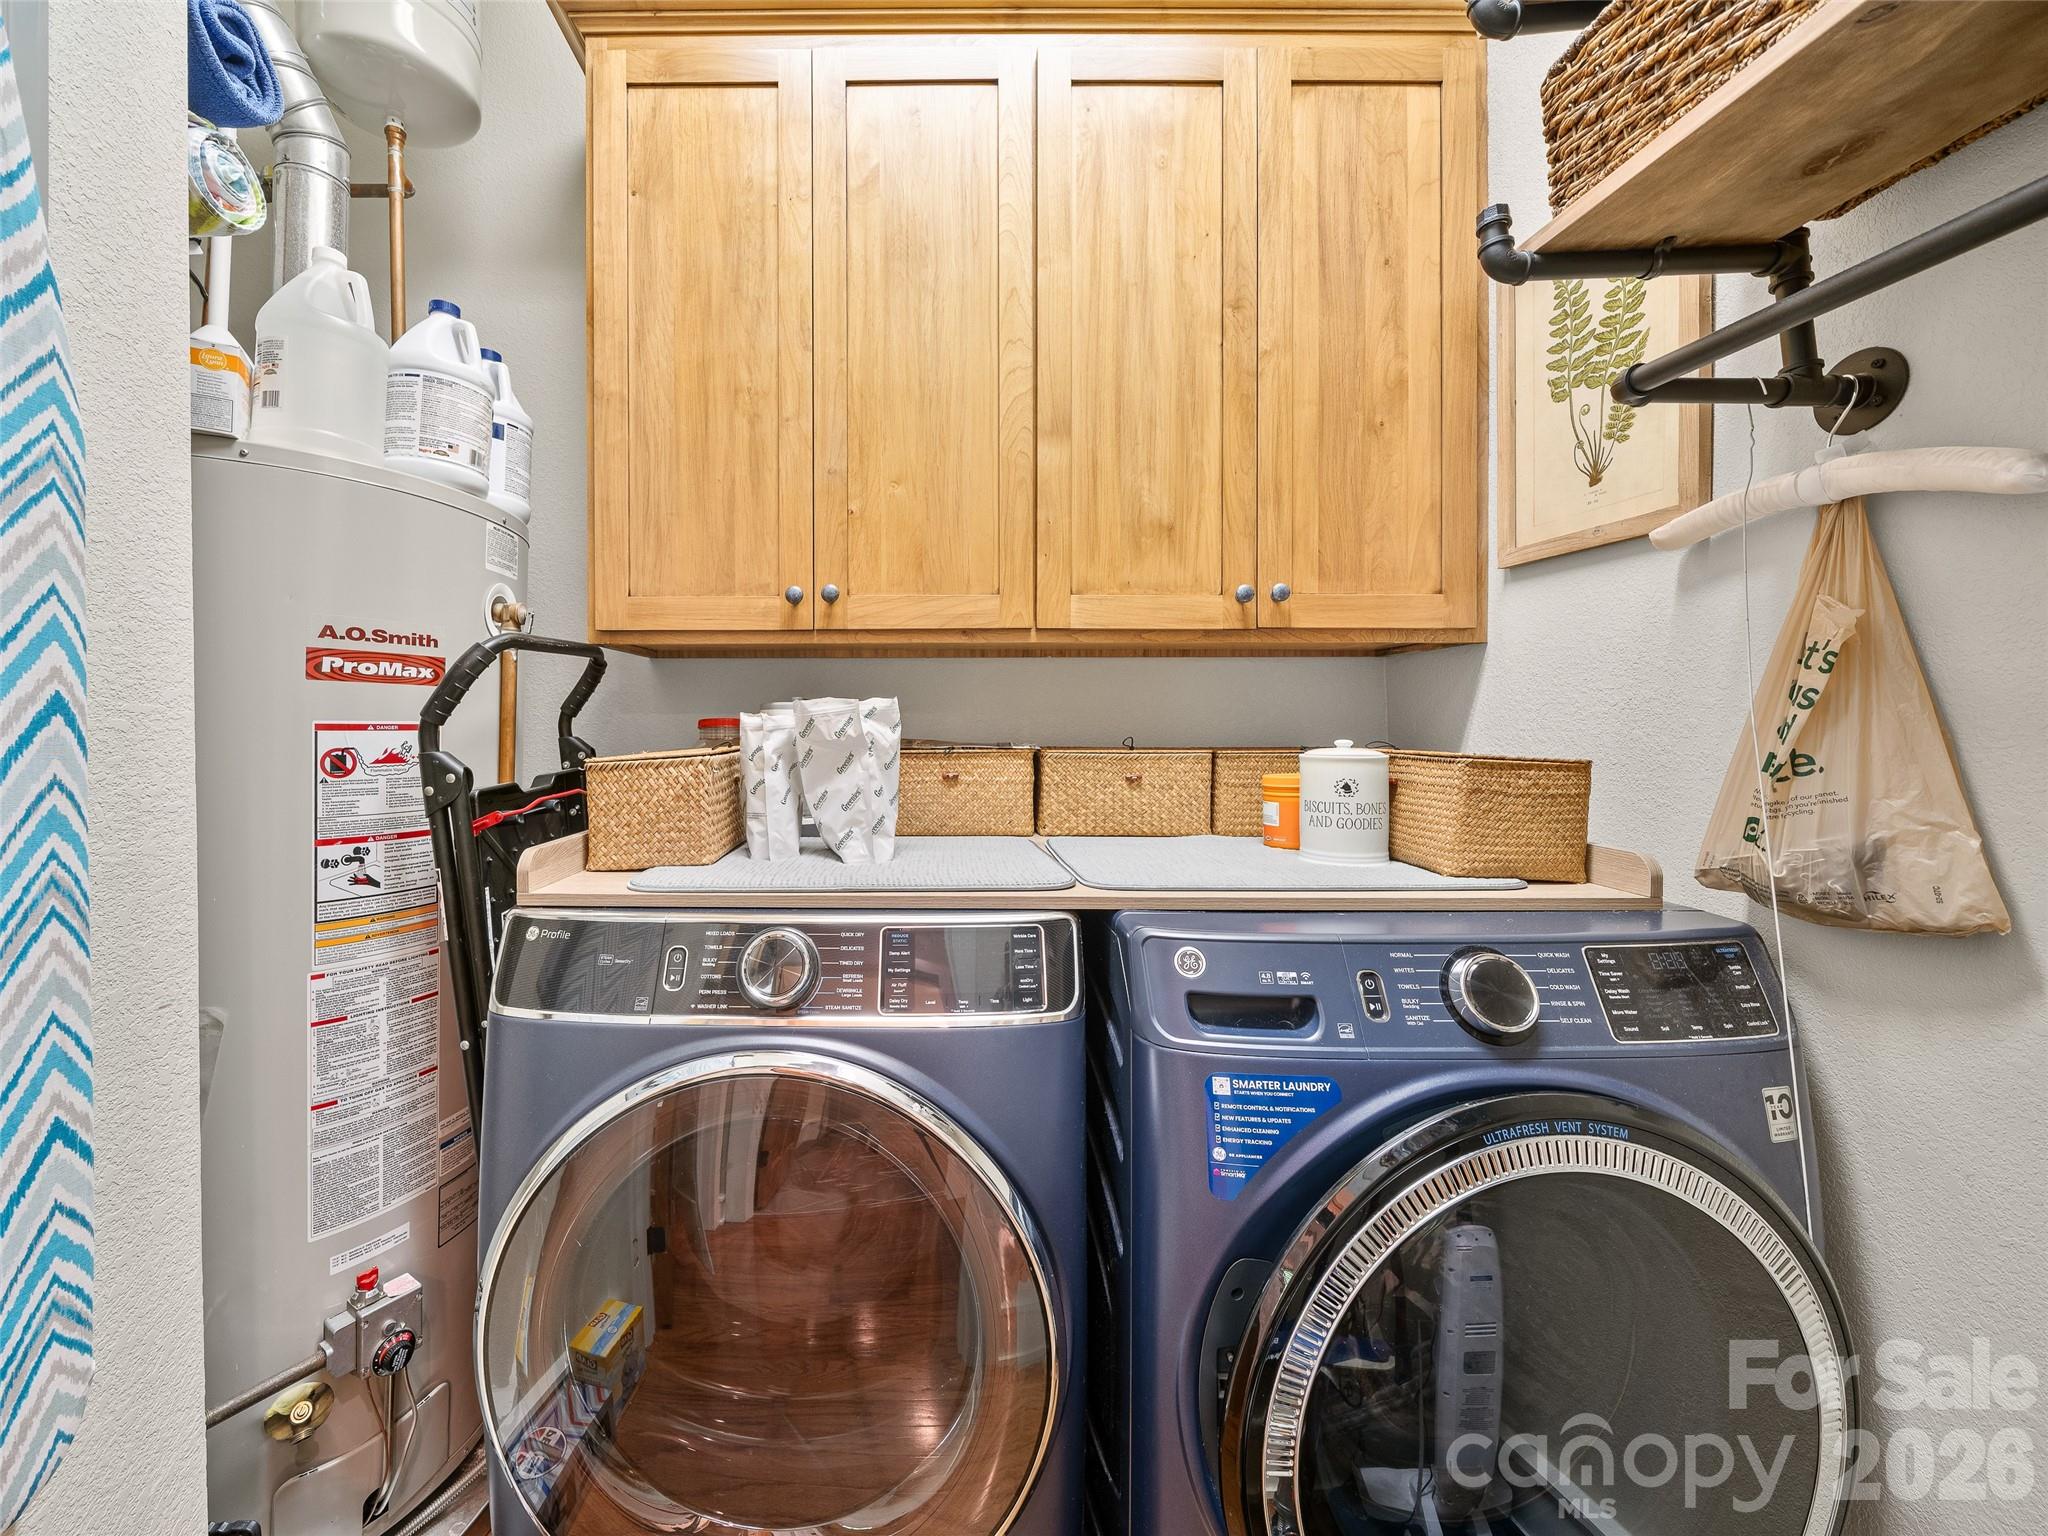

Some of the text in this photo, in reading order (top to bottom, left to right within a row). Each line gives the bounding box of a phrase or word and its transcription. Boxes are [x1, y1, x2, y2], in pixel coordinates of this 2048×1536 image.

[317, 624, 439, 648] A.O.Smith
[320, 656, 434, 679] ProMax
[799, 714, 816, 740] Greenies
[834, 714, 854, 740] Greenies
[836, 751, 855, 775] Greenies
[812, 787, 829, 811] Greenies
[841, 786, 863, 812] Greenies
[1303, 799, 1387, 816] BISCUITS, BONES
[1308, 815, 1383, 830] AND GOODIES
[834, 825, 854, 852] Greenies
[540, 928, 571, 940] Profile
[354, 964, 374, 972] SAFETY
[1232, 1079, 1331, 1092] SMARTER LAUNDRY
[1220, 1103, 1243, 1111] REMOTE
[1242, 1104, 1270, 1112] CONTROL
[1274, 1105, 1316, 1113] NOTIFICATIONS
[1764, 1093, 1793, 1121] 10
[1221, 1114, 1292, 1124] NEW FEATURES & UPDATES
[1221, 1125, 1280, 1135] ENHANCED CLEANING
[1222, 1136, 1273, 1146] ENERGY TRACKING
[1482, 1120, 1629, 1145] ULTRAFRESH VENT SYSTEM
